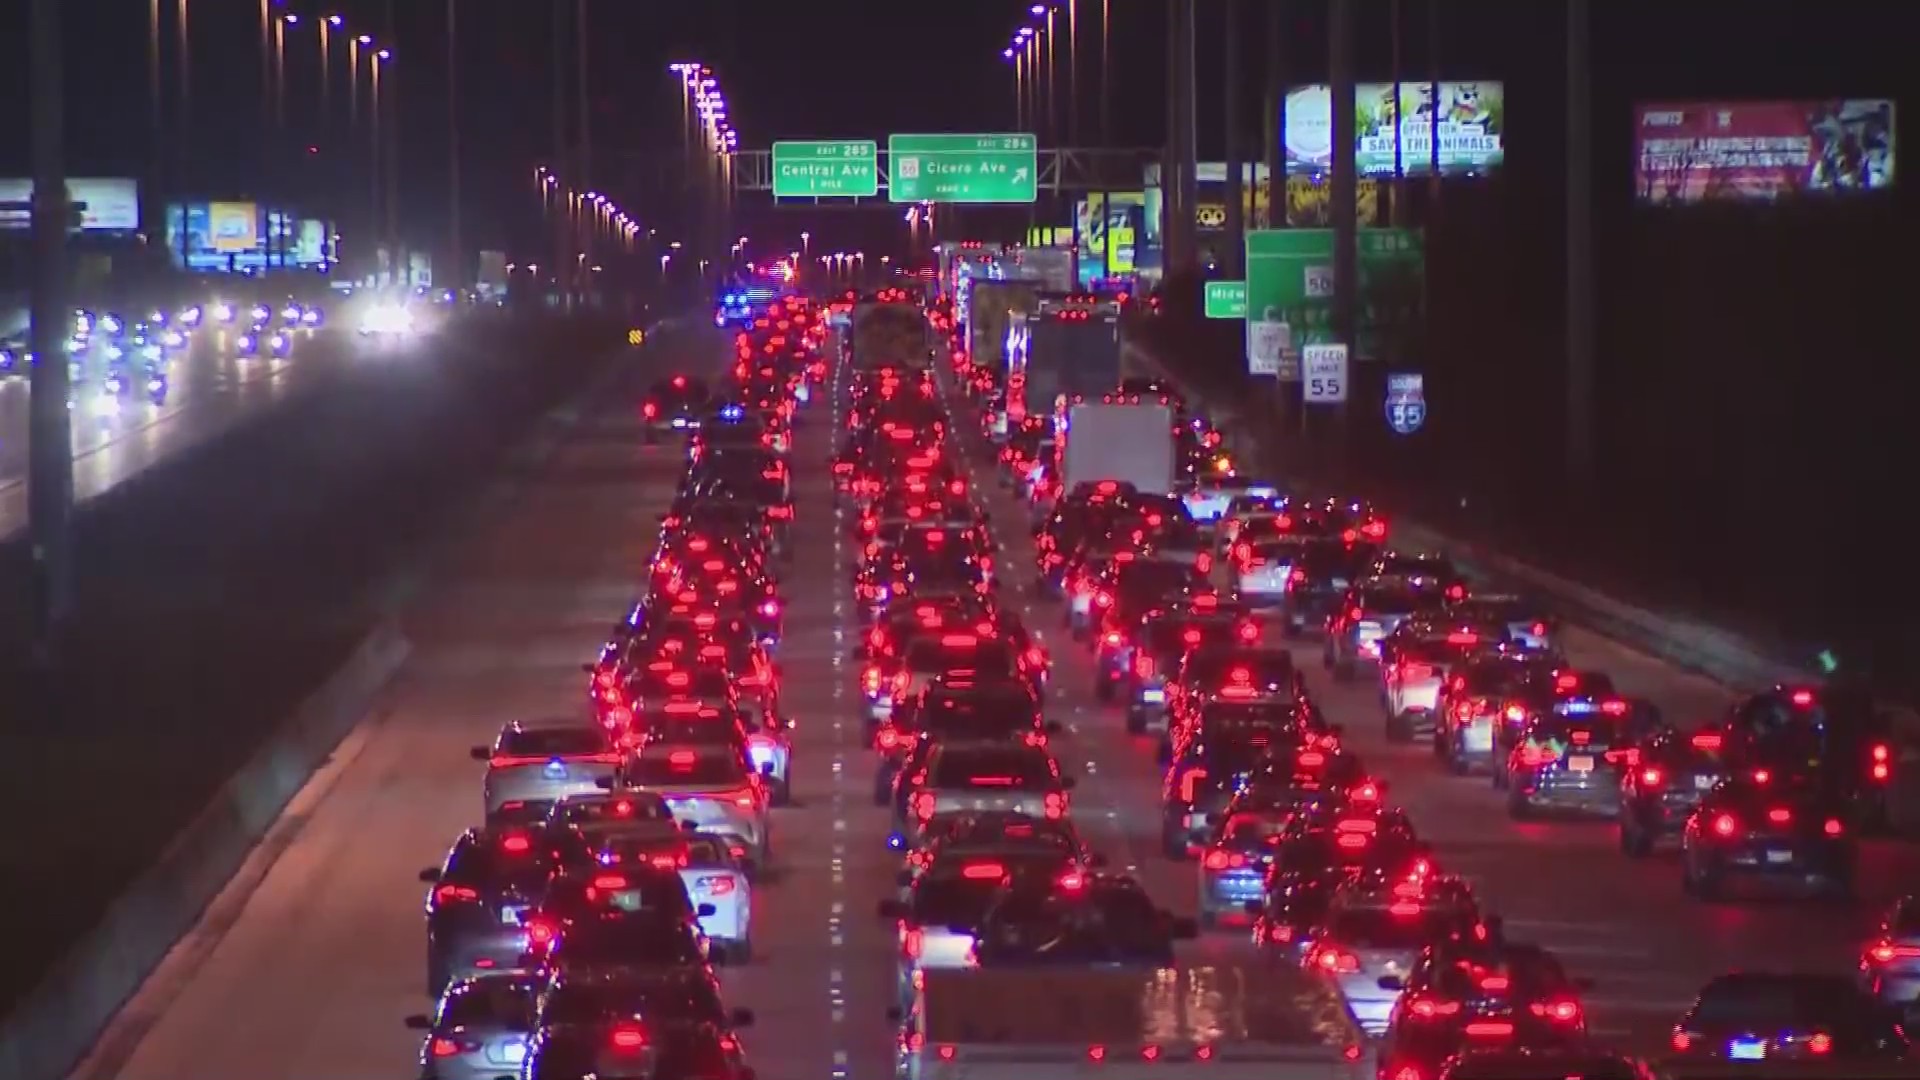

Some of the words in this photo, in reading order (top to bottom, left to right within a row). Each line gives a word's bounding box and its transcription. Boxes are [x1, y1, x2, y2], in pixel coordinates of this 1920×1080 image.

[1003, 138, 1028, 149] 284
[1369, 137, 1397, 150] SAV
[843, 145, 868, 156] 285
[782, 164, 834, 176] Central
[841, 164, 868, 176] Ave
[926, 162, 972, 174] Cicero
[980, 162, 1007, 174] Ave
[1309, 277, 1331, 290] 50
[1306, 349, 1344, 360] SPEED
[1310, 364, 1339, 374] LIMIT
[1310, 379, 1340, 395] 55
[1392, 405, 1421, 425] 55
